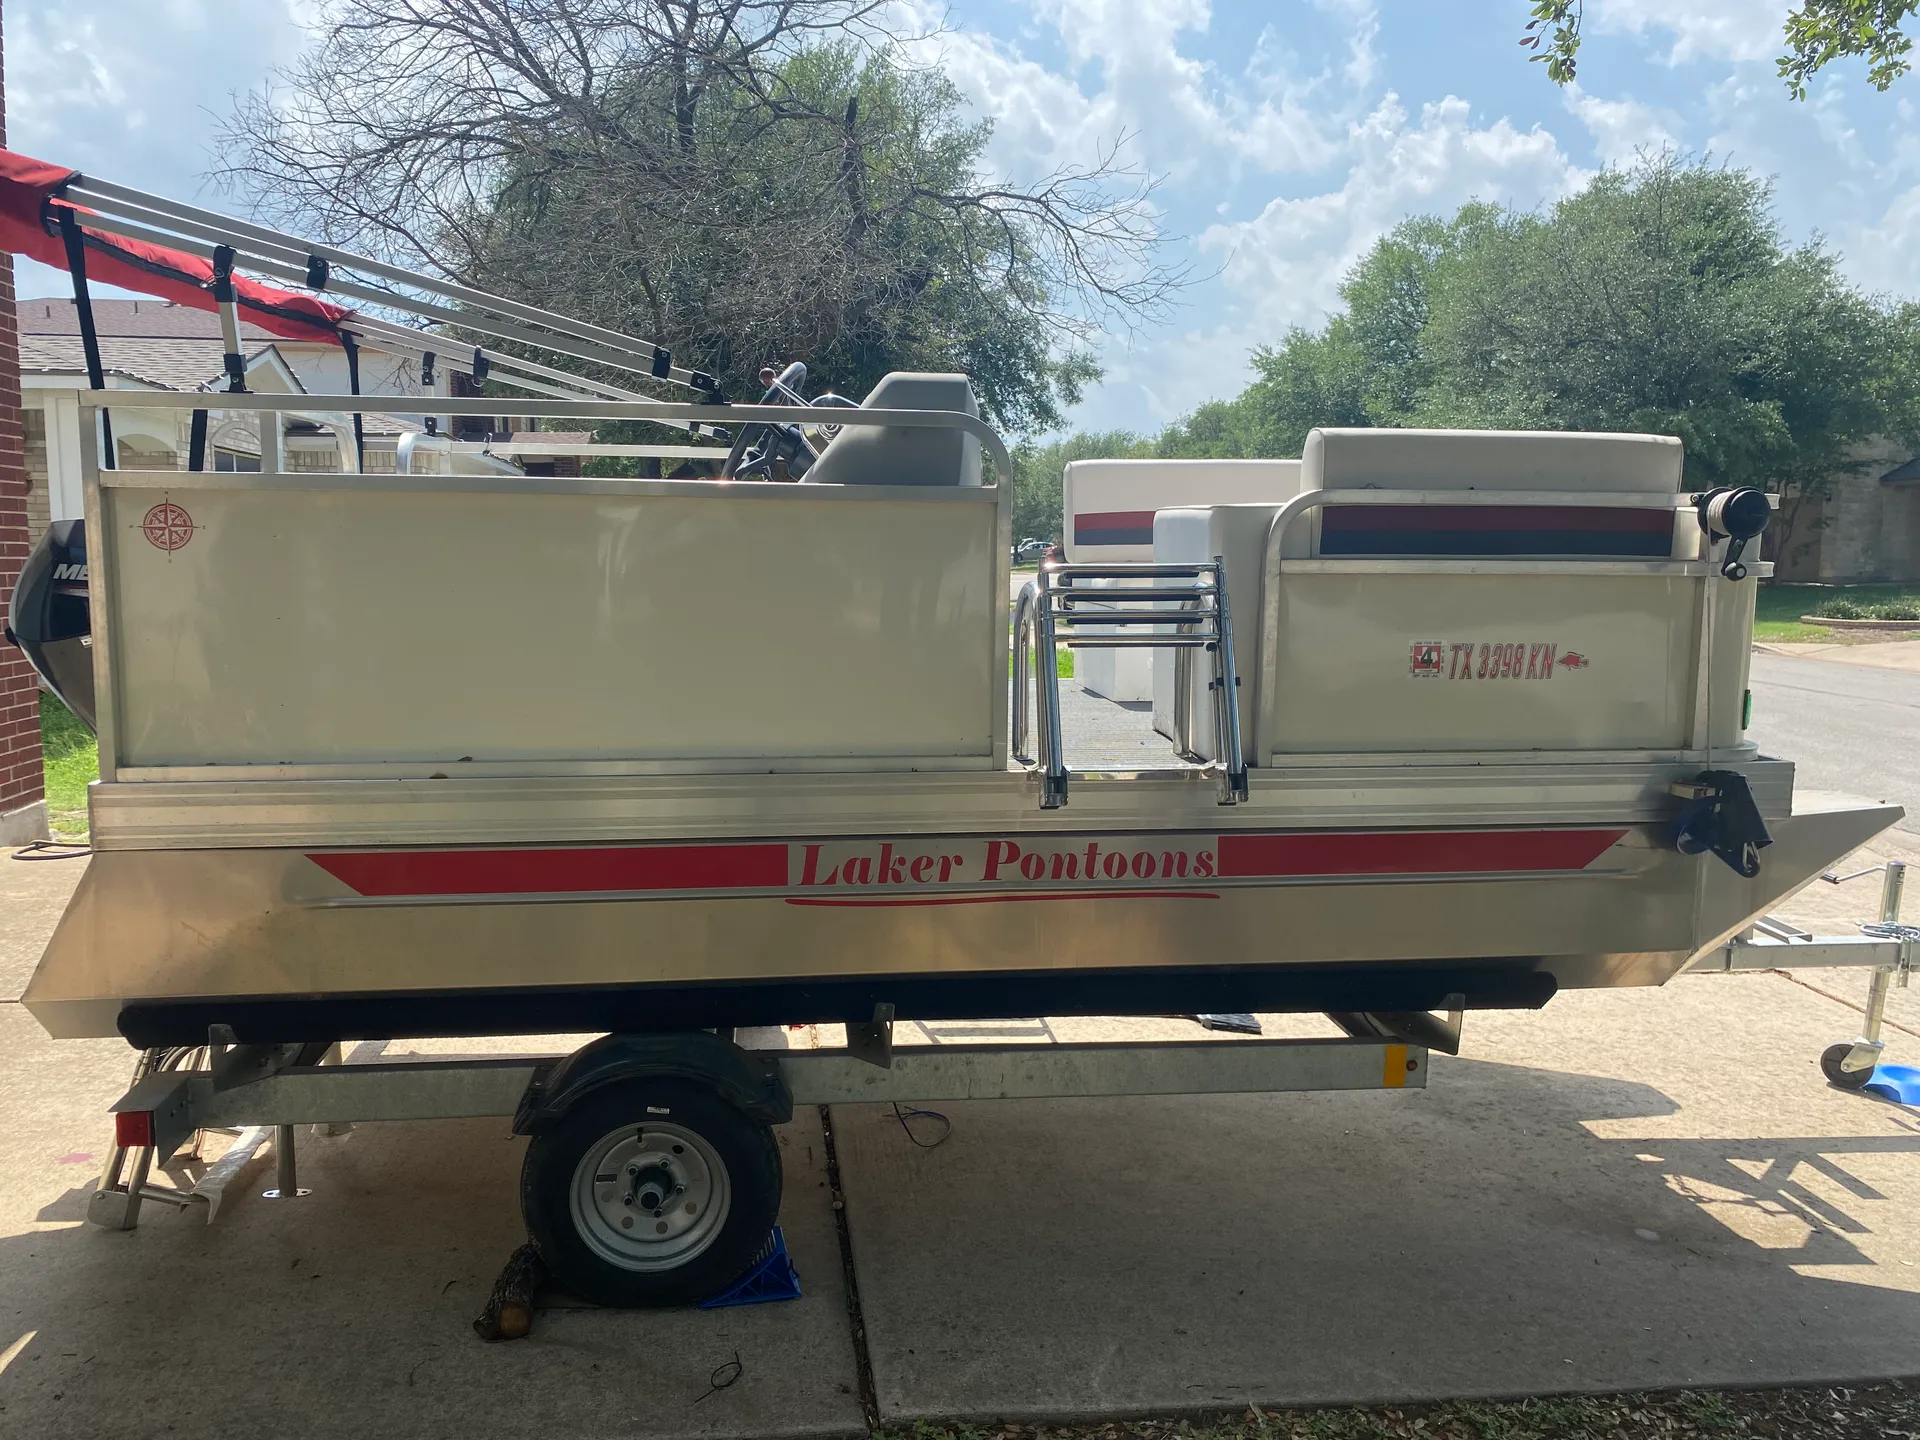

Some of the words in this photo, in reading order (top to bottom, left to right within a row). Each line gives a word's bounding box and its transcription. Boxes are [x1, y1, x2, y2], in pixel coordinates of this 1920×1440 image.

[1420, 647, 1433, 669] 4
[1449, 643, 1475, 679] TX
[1477, 643, 1526, 679] 3398
[1525, 643, 1557, 679] KN
[798, 843, 963, 886] Laker
[979, 840, 1217, 881] Pontoons
